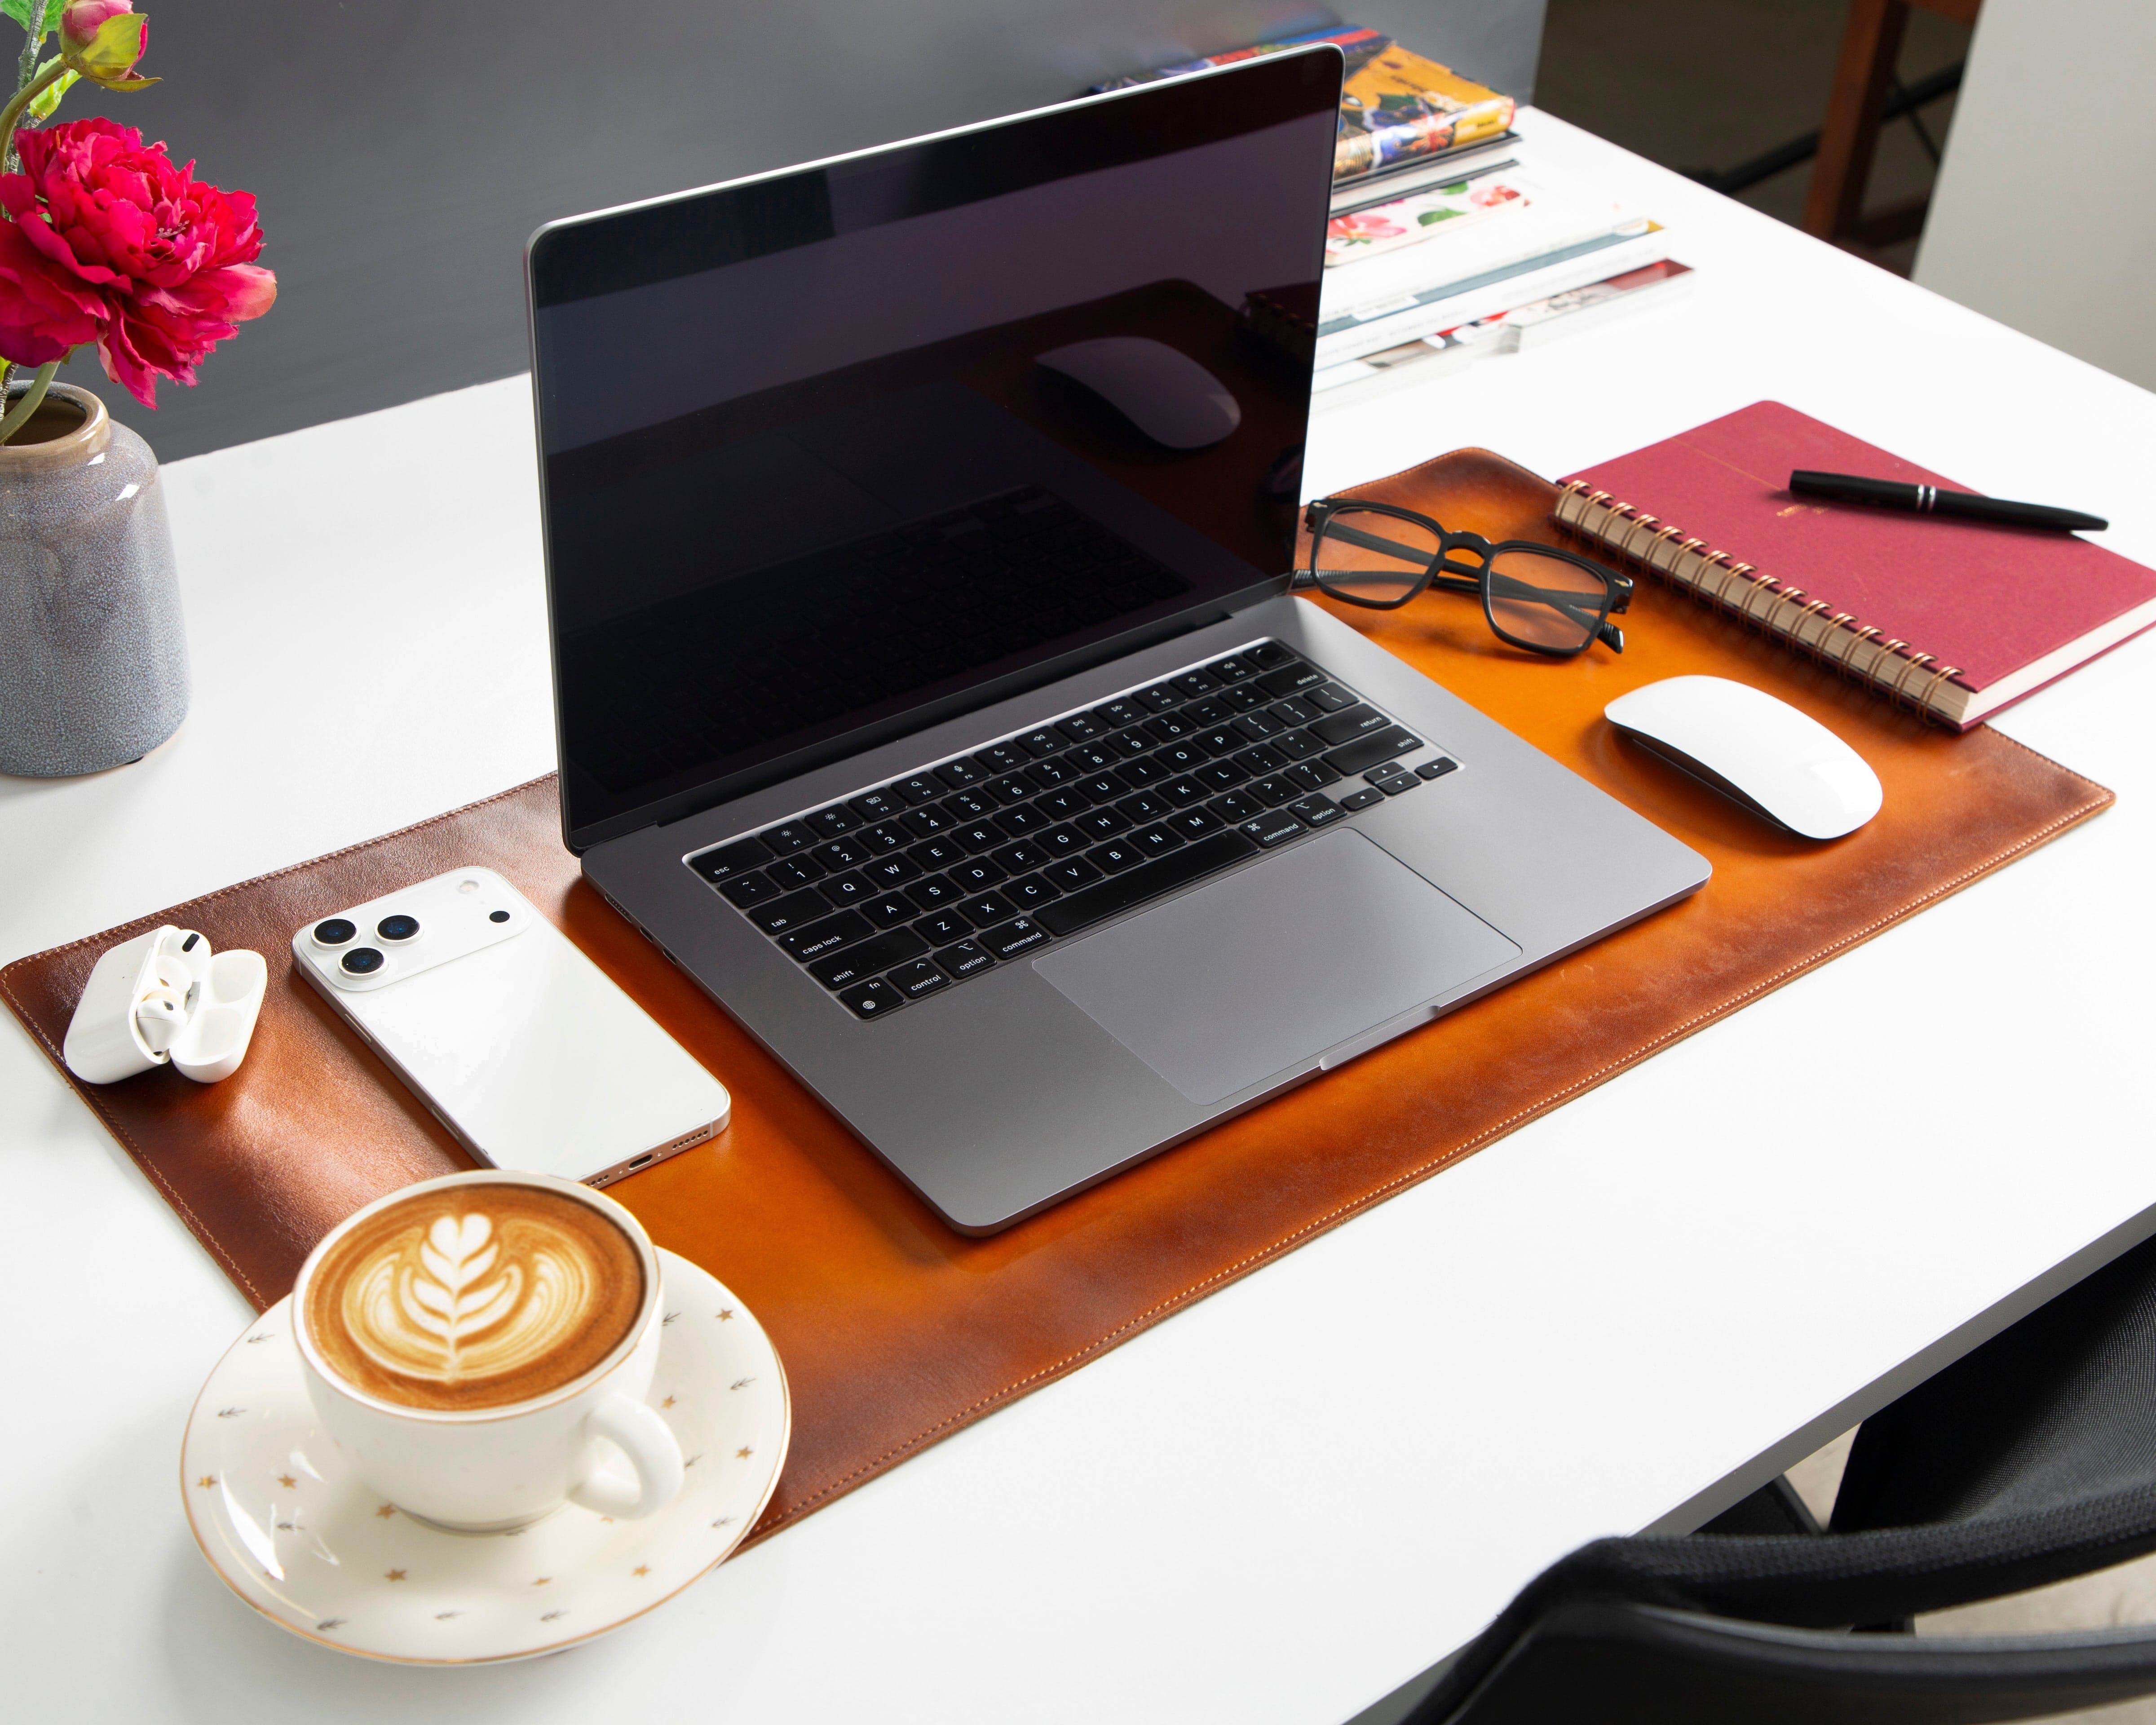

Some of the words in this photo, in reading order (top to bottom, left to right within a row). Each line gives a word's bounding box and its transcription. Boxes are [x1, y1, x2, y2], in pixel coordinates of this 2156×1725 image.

[1297, 674, 1318, 685] delete
[1360, 717, 1382, 727] return
[1397, 738, 1415, 748] shift
[1096, 782, 1109, 790] U
[1178, 786, 1190, 794] K
[1312, 808, 1335, 820] option
[1097, 818, 1111, 827] H
[1189, 817, 1203, 826] M
[973, 832, 986, 840] R
[1264, 823, 1299, 841] command
[1149, 834, 1163, 843] N
[931, 848, 943, 857] E
[1015, 852, 1024, 860] F
[1109, 851, 1122, 859] B
[714, 867, 729, 875] esc
[884, 864, 899, 874] W
[972, 869, 984, 877] D
[1067, 868, 1078, 876] V
[843, 883, 856, 891] Q
[886, 905, 897, 913] A
[981, 903, 994, 913] X
[937, 921, 950, 930] Z
[803, 944, 823, 954] caps
[822, 936, 842, 946] lock
[1003, 932, 1042, 952] command
[959, 956, 986, 970] option
[833, 970, 854, 982] shift
[911, 974, 941, 991] control
